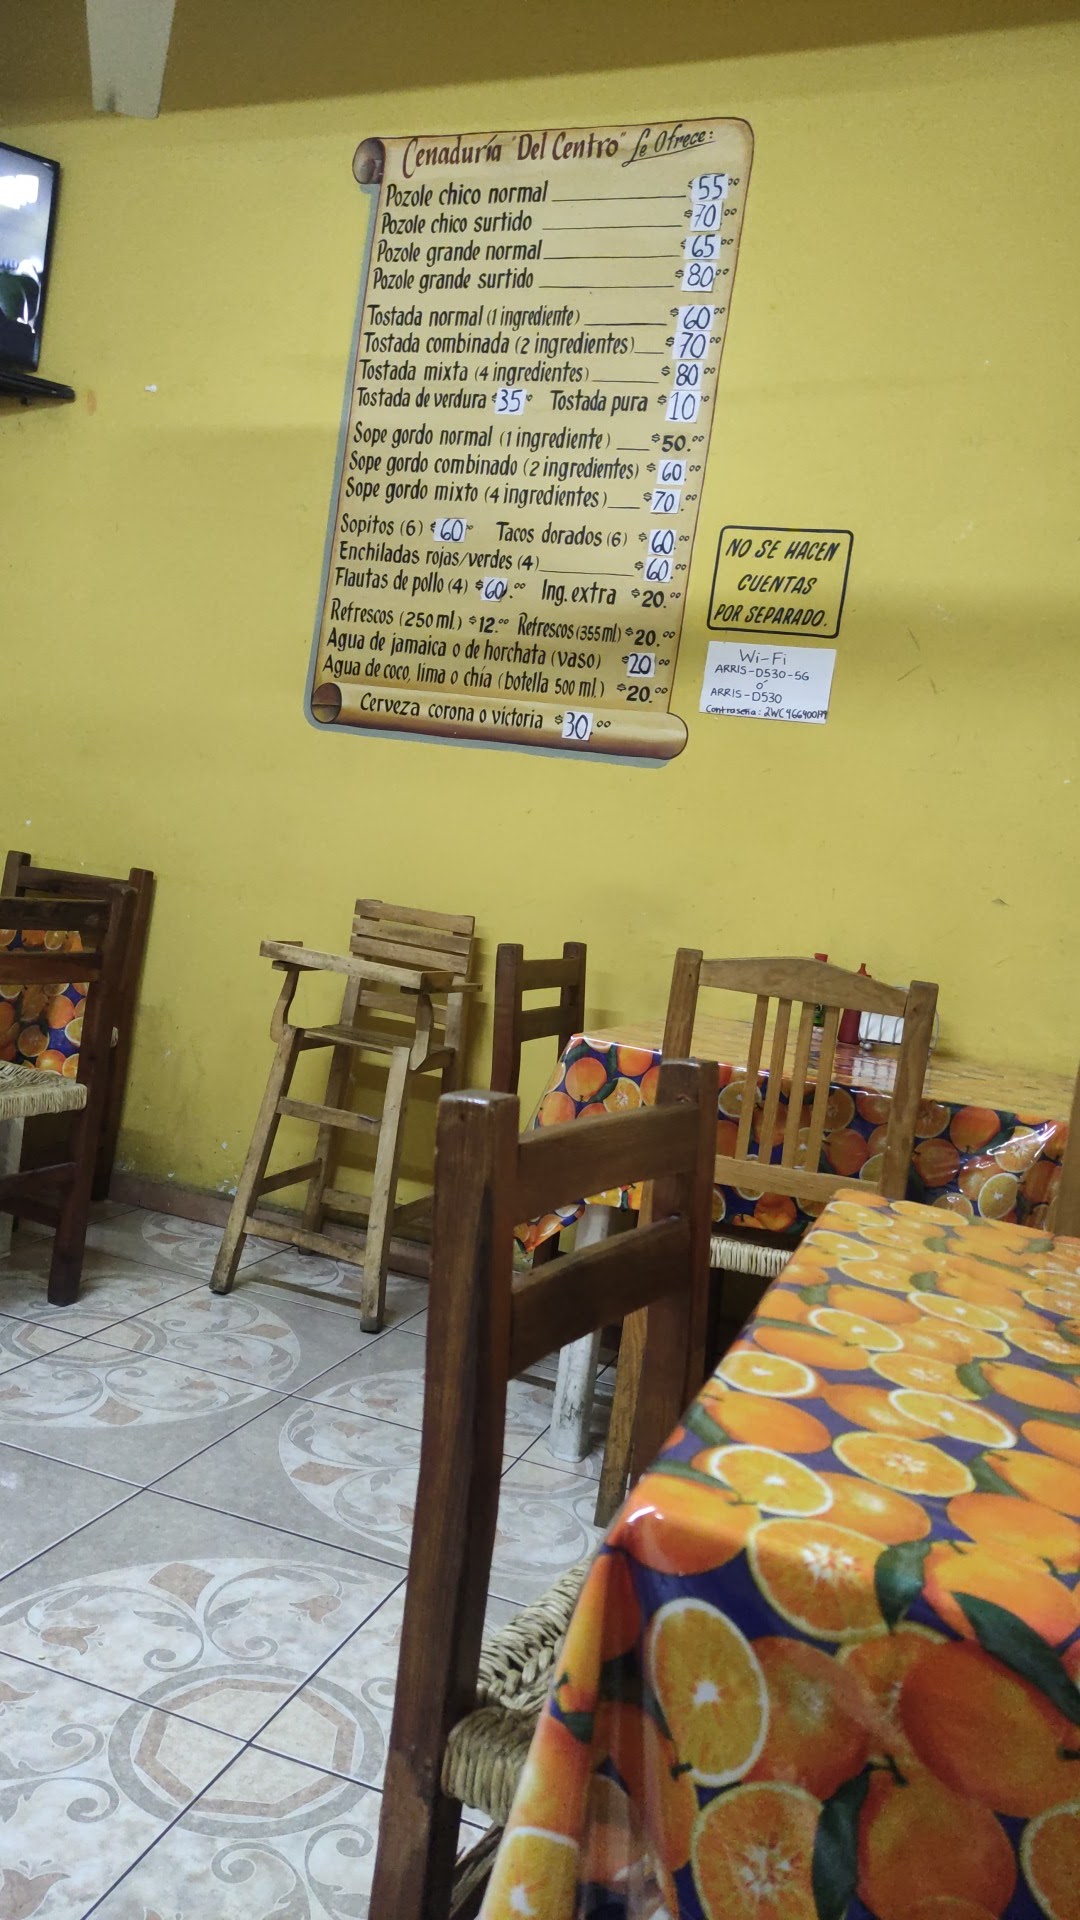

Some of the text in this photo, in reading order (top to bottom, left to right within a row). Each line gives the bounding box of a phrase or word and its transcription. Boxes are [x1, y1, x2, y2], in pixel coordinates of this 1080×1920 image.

[654, 124, 714, 152] Ofrece:
[400, 135, 502, 178] Cenaduría
[386, 184, 434, 207] Pozole
[439, 184, 481, 204] chico
[489, 181, 548, 203] normal
[381, 212, 426, 234] Pozole
[431, 214, 469, 233] chico
[474, 213, 532, 232] surtido
[377, 241, 420, 263] Pozole
[426, 242, 481, 265] grande
[486, 241, 542, 261] normal
[373, 267, 415, 289] Pozole
[419, 267, 472, 293] grande
[478, 266, 533, 289] surtido
[367, 304, 422, 327] Tostada
[429, 305, 482, 327] normal
[500, 308, 580, 331] ingrediente)
[364, 332, 422, 354] Tostada
[426, 334, 510, 353] combinada
[535, 333, 634, 358] ingredientes)
[359, 359, 416, 381] Tostada
[424, 361, 468, 381] mixta
[492, 363, 589, 386] ingredientes)
[356, 386, 410, 408] Tostada
[415, 389, 431, 408] de
[433, 389, 486, 409] verdura
[550, 389, 606, 412] Tostada
[611, 392, 648, 416] pura
[353, 421, 387, 446] Sope
[391, 422, 433, 447] gordo
[439, 425, 492, 449] normal
[512, 426, 611, 453] ingrediente)
[349, 451, 382, 474] Sope
[386, 452, 428, 477] gordo
[434, 452, 518, 478] combinado
[544, 456, 639, 482] ingredientes)
[346, 476, 379, 501] Sope
[386, 478, 428, 504] gordo
[434, 482, 478, 502] mixto
[503, 484, 607, 512] ingredientes)
[341, 513, 394, 536] Sopitos
[400, 519, 422, 538] (6)
[496, 521, 534, 544] Tacos
[541, 521, 602, 548] dorados
[606, 532, 628, 548] (6)
[339, 541, 419, 565] Enchiladas
[426, 546, 512, 570] rojas/verdes
[518, 555, 539, 571] (4)
[725, 538, 840, 562] NO SE HACEN
[335, 567, 388, 590] Flautas
[393, 571, 408, 591] de
[412, 571, 444, 597] pollo
[448, 578, 468, 594] (4)
[738, 574, 817, 594] CUENTAS
[330, 598, 394, 625] Refrescos
[714, 604, 827, 627] POR SEPARADO.
[518, 612, 573, 640] Refrescos
[326, 628, 364, 652] Agua
[369, 631, 385, 650] de
[390, 631, 446, 656] jamaica
[452, 644, 461, 658] o
[464, 637, 480, 659] de
[484, 638, 546, 665] horchata
[551, 651, 601, 668] (vaso)
[740, 649, 787, 665] Wi-Fi
[322, 656, 360, 678] Agua
[364, 659, 381, 676] de
[383, 666, 411, 683] coco,
[417, 663, 445, 684] lima
[451, 671, 458, 684] o
[463, 664, 491, 687] chía
[499, 670, 549, 694] (botella
[710, 688, 782, 704] ARRIS-D530
[361, 693, 420, 716] Cerveza
[428, 703, 474, 722] corona
[479, 711, 487, 722] o
[491, 709, 542, 728] victoria
